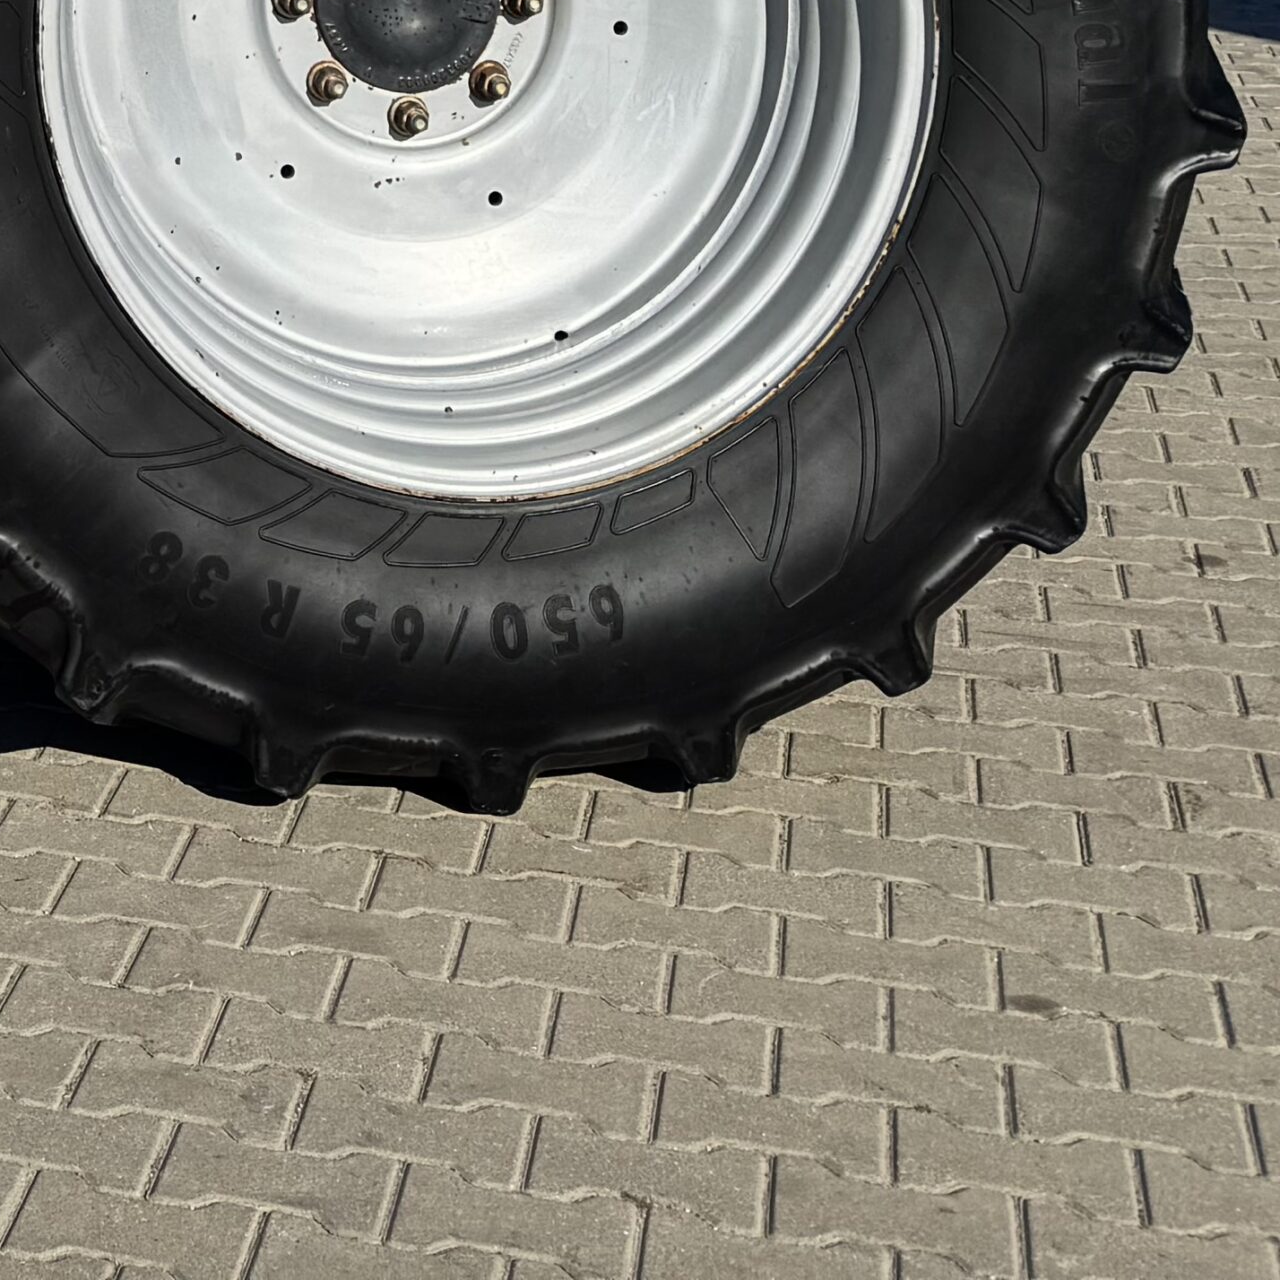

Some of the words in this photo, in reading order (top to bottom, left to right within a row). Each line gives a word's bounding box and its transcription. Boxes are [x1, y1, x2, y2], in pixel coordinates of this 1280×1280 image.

[135, 530, 230, 610] 38
[258, 578, 302, 639] R
[336, 582, 626, 665] 650/65
